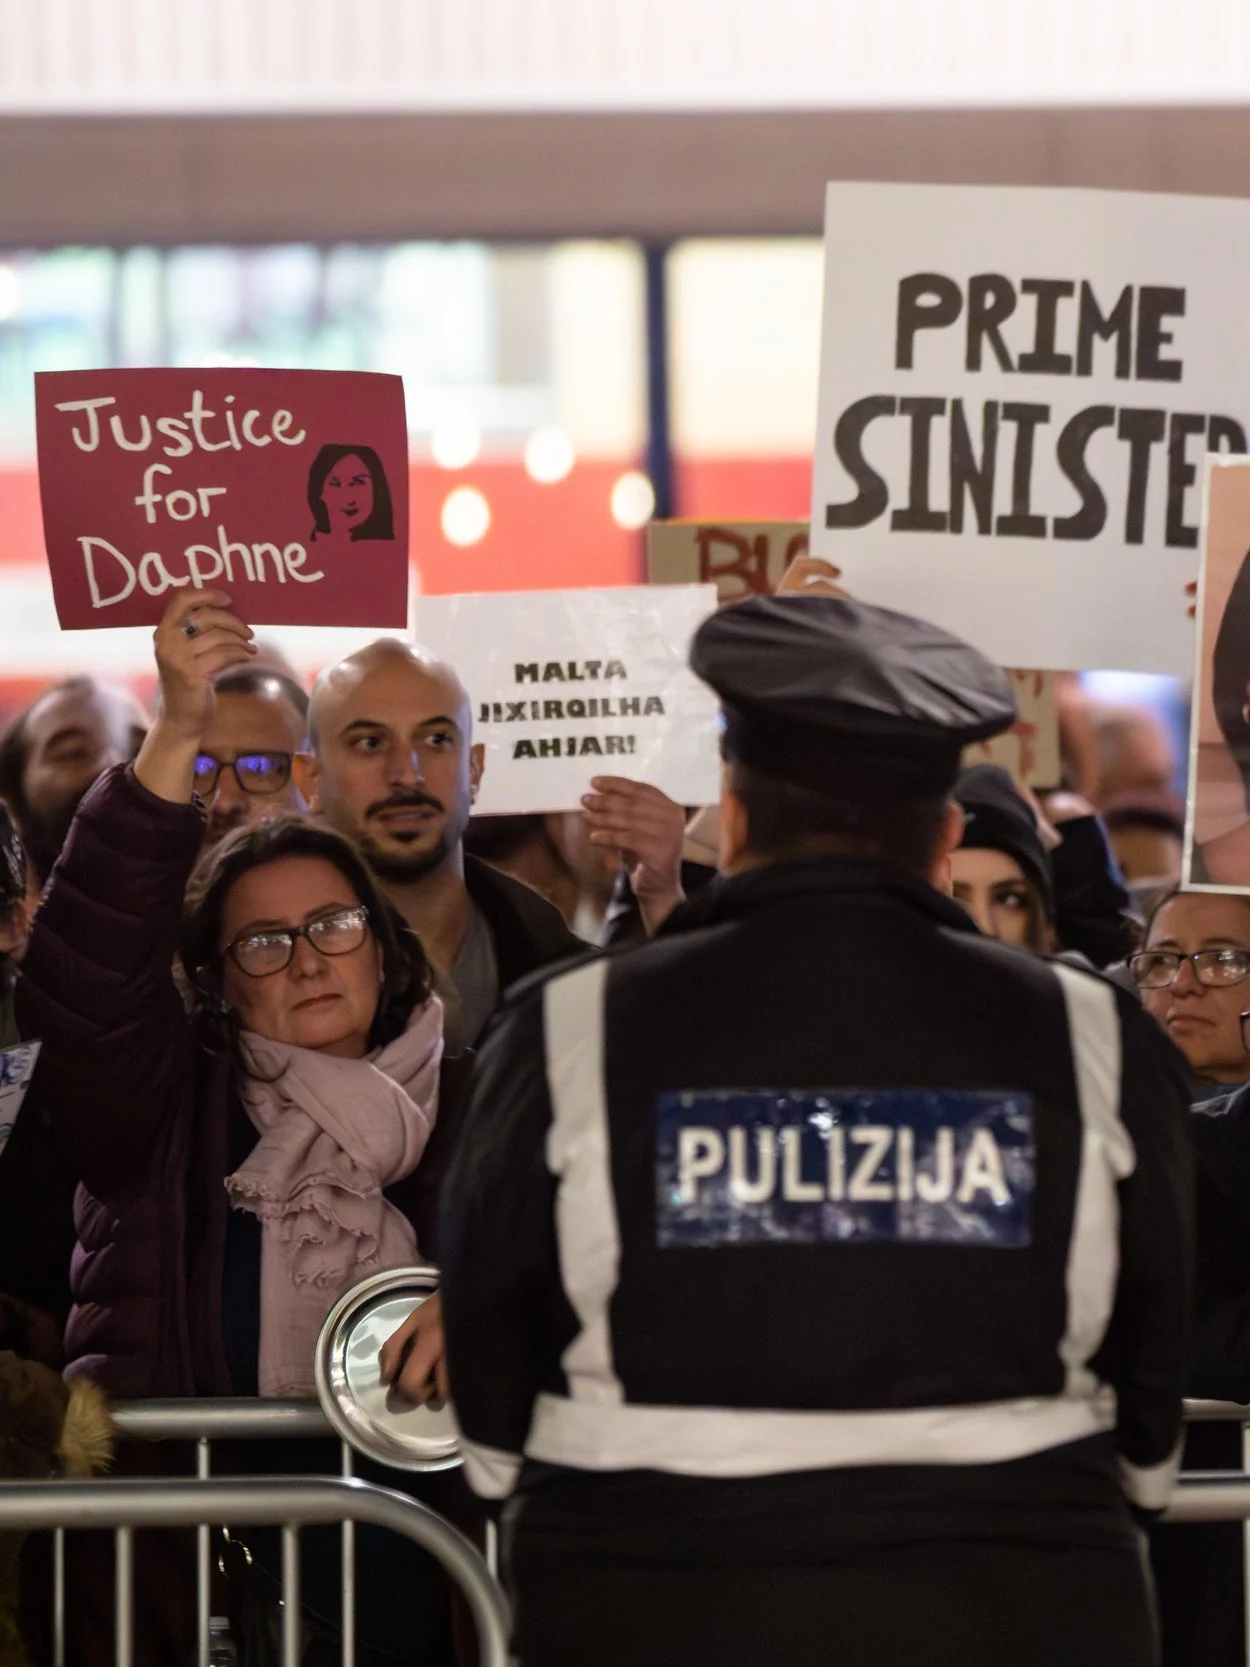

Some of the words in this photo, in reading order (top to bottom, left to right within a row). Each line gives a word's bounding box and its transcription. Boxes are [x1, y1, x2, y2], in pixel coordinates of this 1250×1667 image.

[895, 272, 1187, 383] PRIME
[54, 389, 306, 458] Justice
[135, 463, 227, 524] for
[77, 525, 325, 609] Daphne
[514, 660, 628, 684] MALTA
[478, 696, 666, 724] JIXIRQILHA
[512, 735, 637, 760] AHJAR!
[677, 1124, 1012, 1207] PULIZIJA
